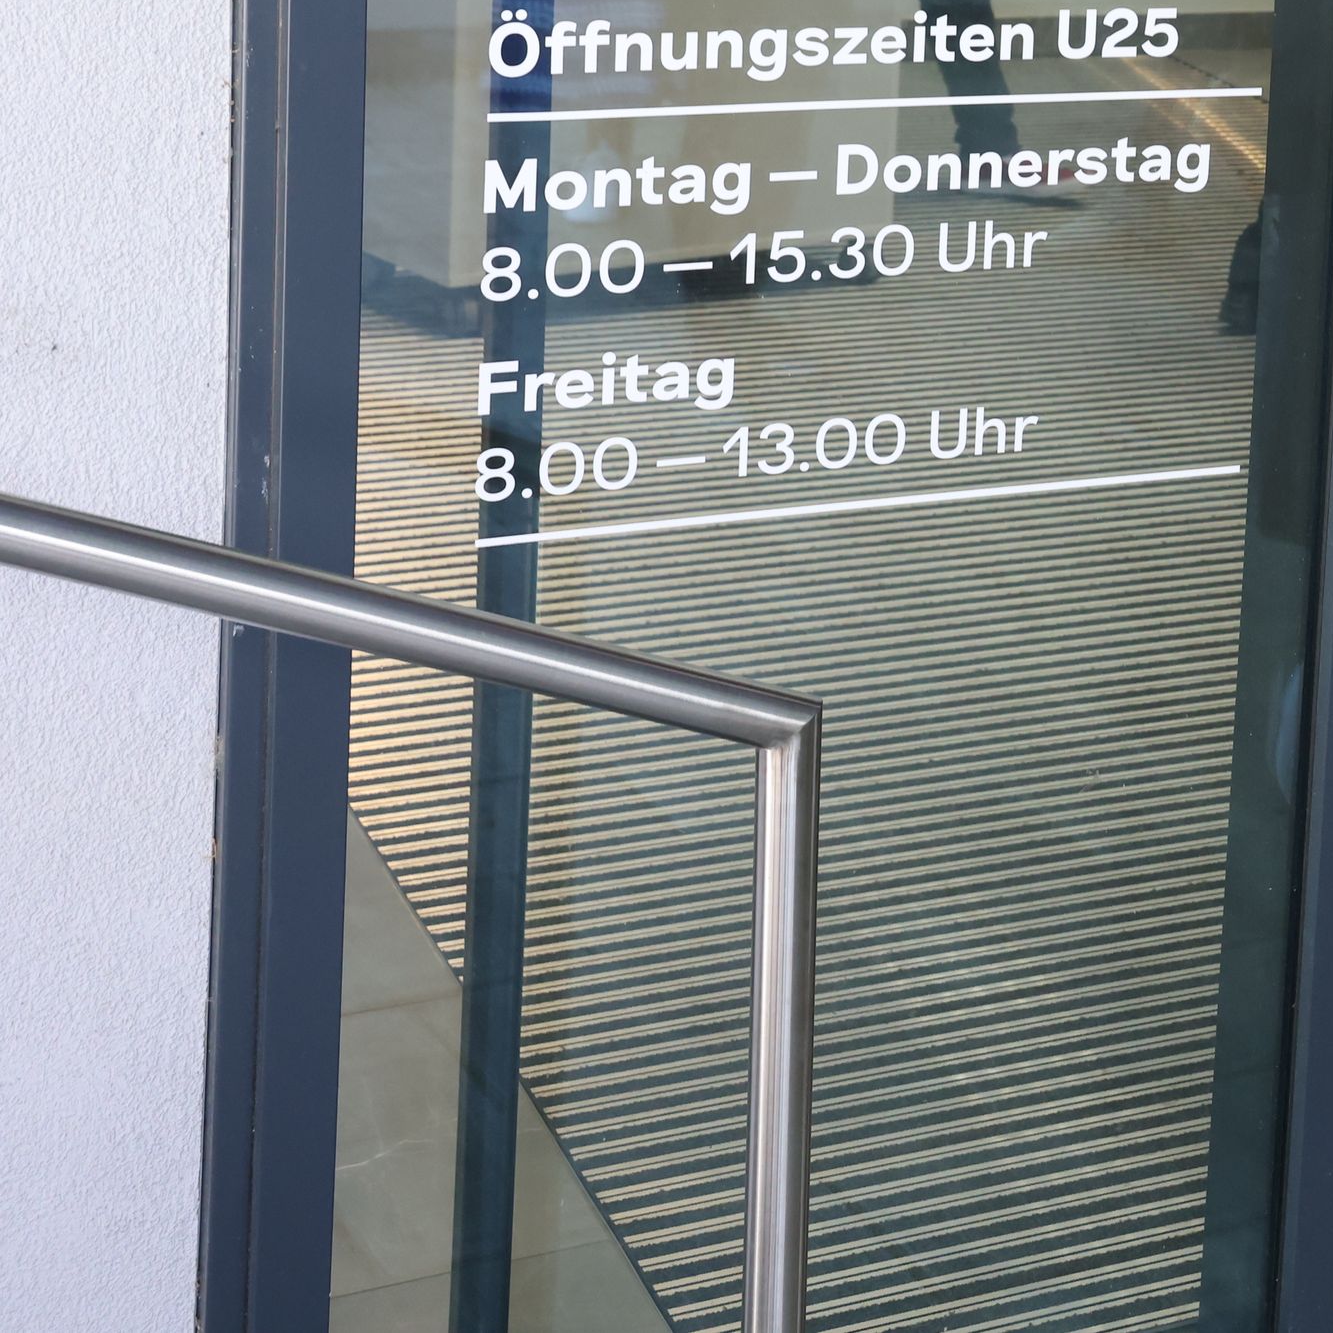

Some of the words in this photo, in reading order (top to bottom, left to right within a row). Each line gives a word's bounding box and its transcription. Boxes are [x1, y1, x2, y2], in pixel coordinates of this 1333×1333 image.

[488, 9, 1034, 82] Öffnungszeiten
[1057, 7, 1179, 60] U25
[483, 156, 751, 215] Montag
[836, 137, 1211, 196] Donnerstag
[480, 239, 645, 302] 8.00
[730, 224, 915, 284] 15.30
[938, 220, 1048, 272] Uhr
[477, 351, 735, 416] Freitag
[473, 436, 638, 502] 8.00
[722, 413, 906, 477] 13.00
[930, 406, 1039, 459] Uhr
